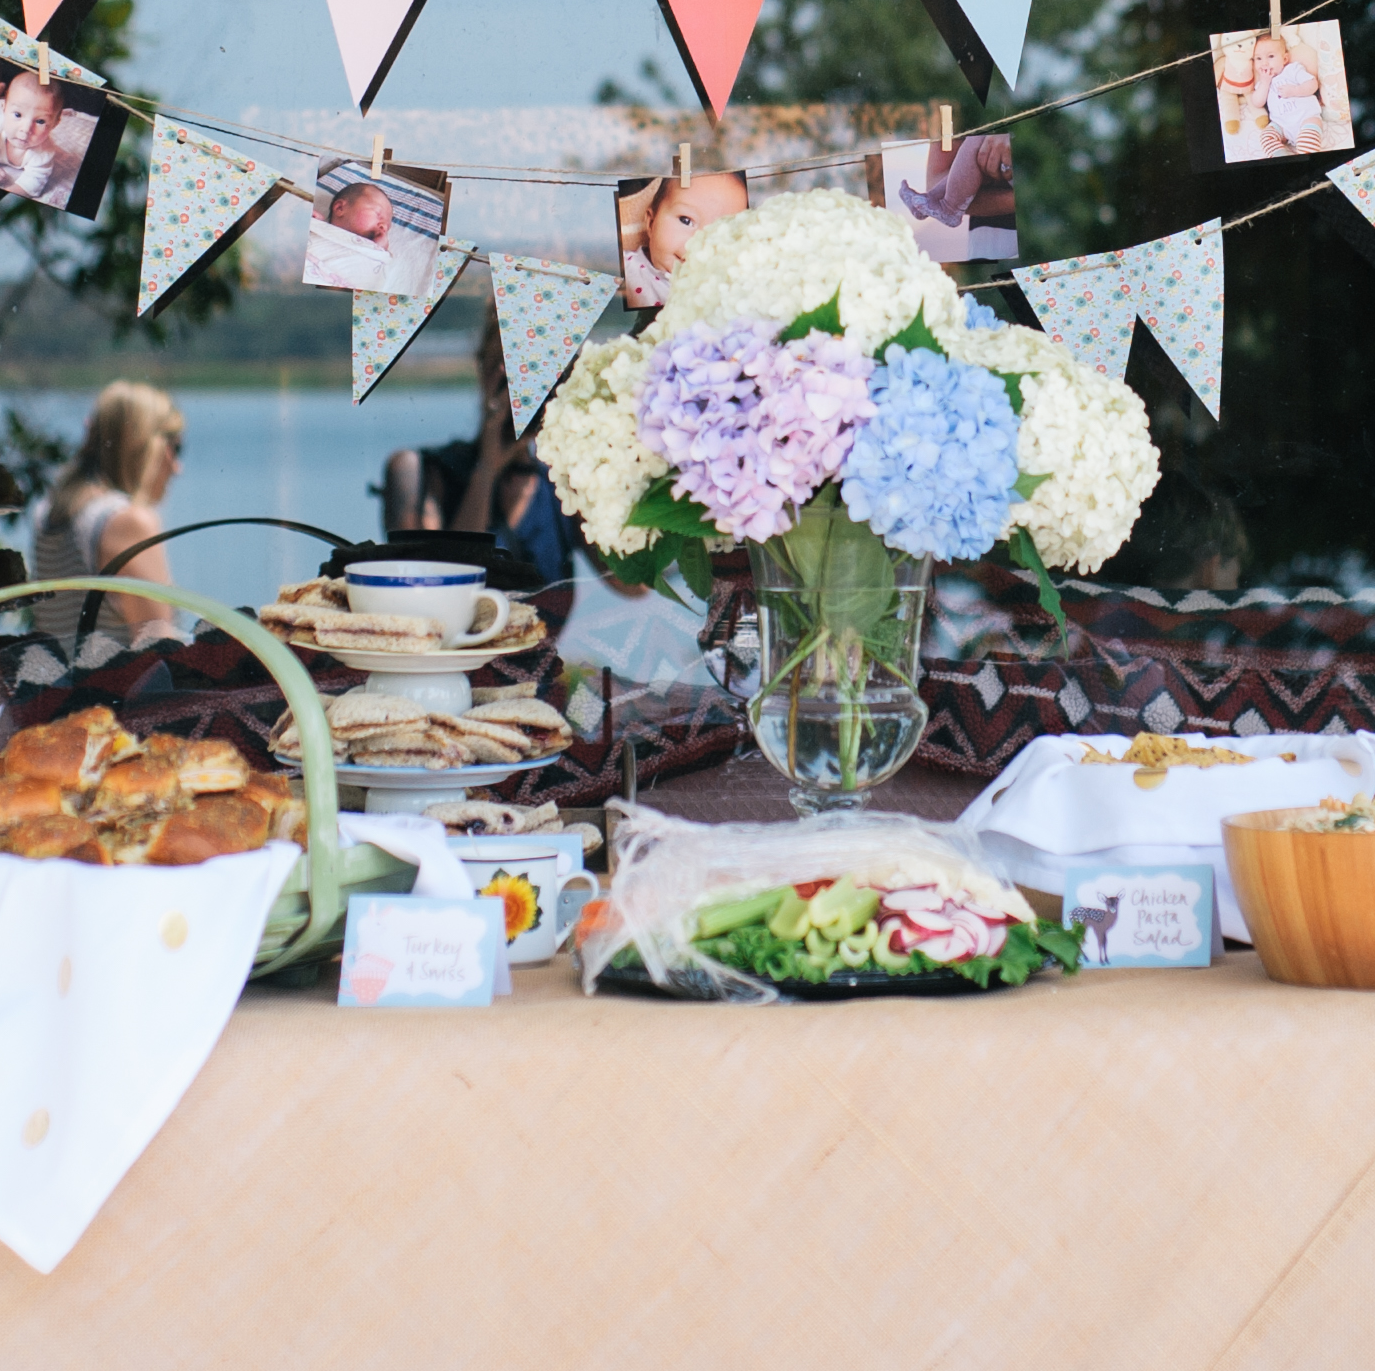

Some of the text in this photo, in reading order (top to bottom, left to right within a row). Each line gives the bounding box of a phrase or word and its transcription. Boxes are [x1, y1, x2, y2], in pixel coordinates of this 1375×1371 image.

[1131, 889, 1189, 906] Chicken
[1137, 909, 1181, 928] Pasta
[402, 934, 463, 968] Turkey
[1133, 929, 1193, 951] Salad
[419, 961, 466, 983] Swiss
